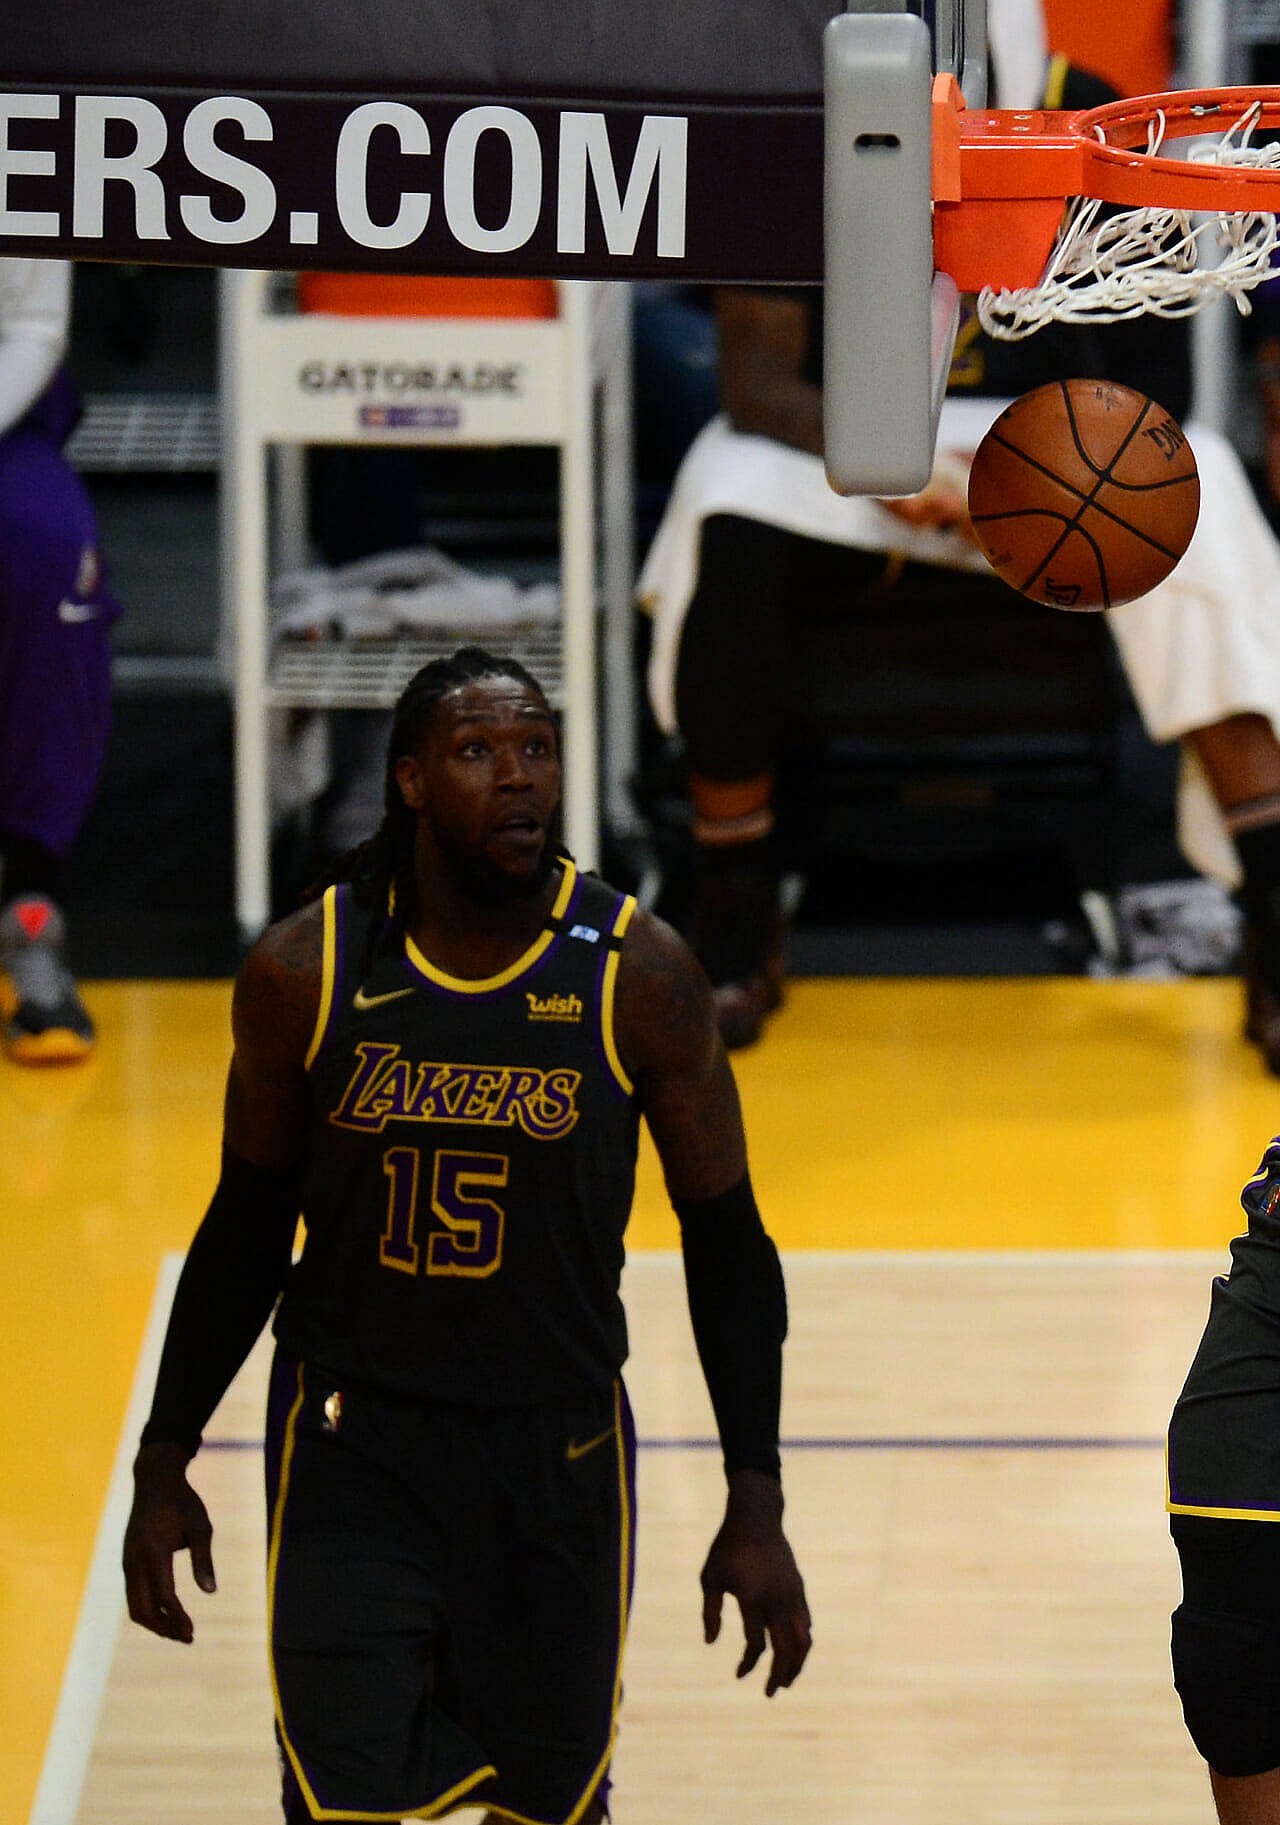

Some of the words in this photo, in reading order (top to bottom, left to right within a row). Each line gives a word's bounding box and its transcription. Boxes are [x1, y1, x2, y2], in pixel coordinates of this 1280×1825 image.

[0, 93, 689, 258] ERS.COM
[299, 360, 519, 394] GATORADE
[525, 992, 583, 1014] wish
[329, 1041, 582, 1141] LAKERS
[379, 1146, 510, 1279] 15
